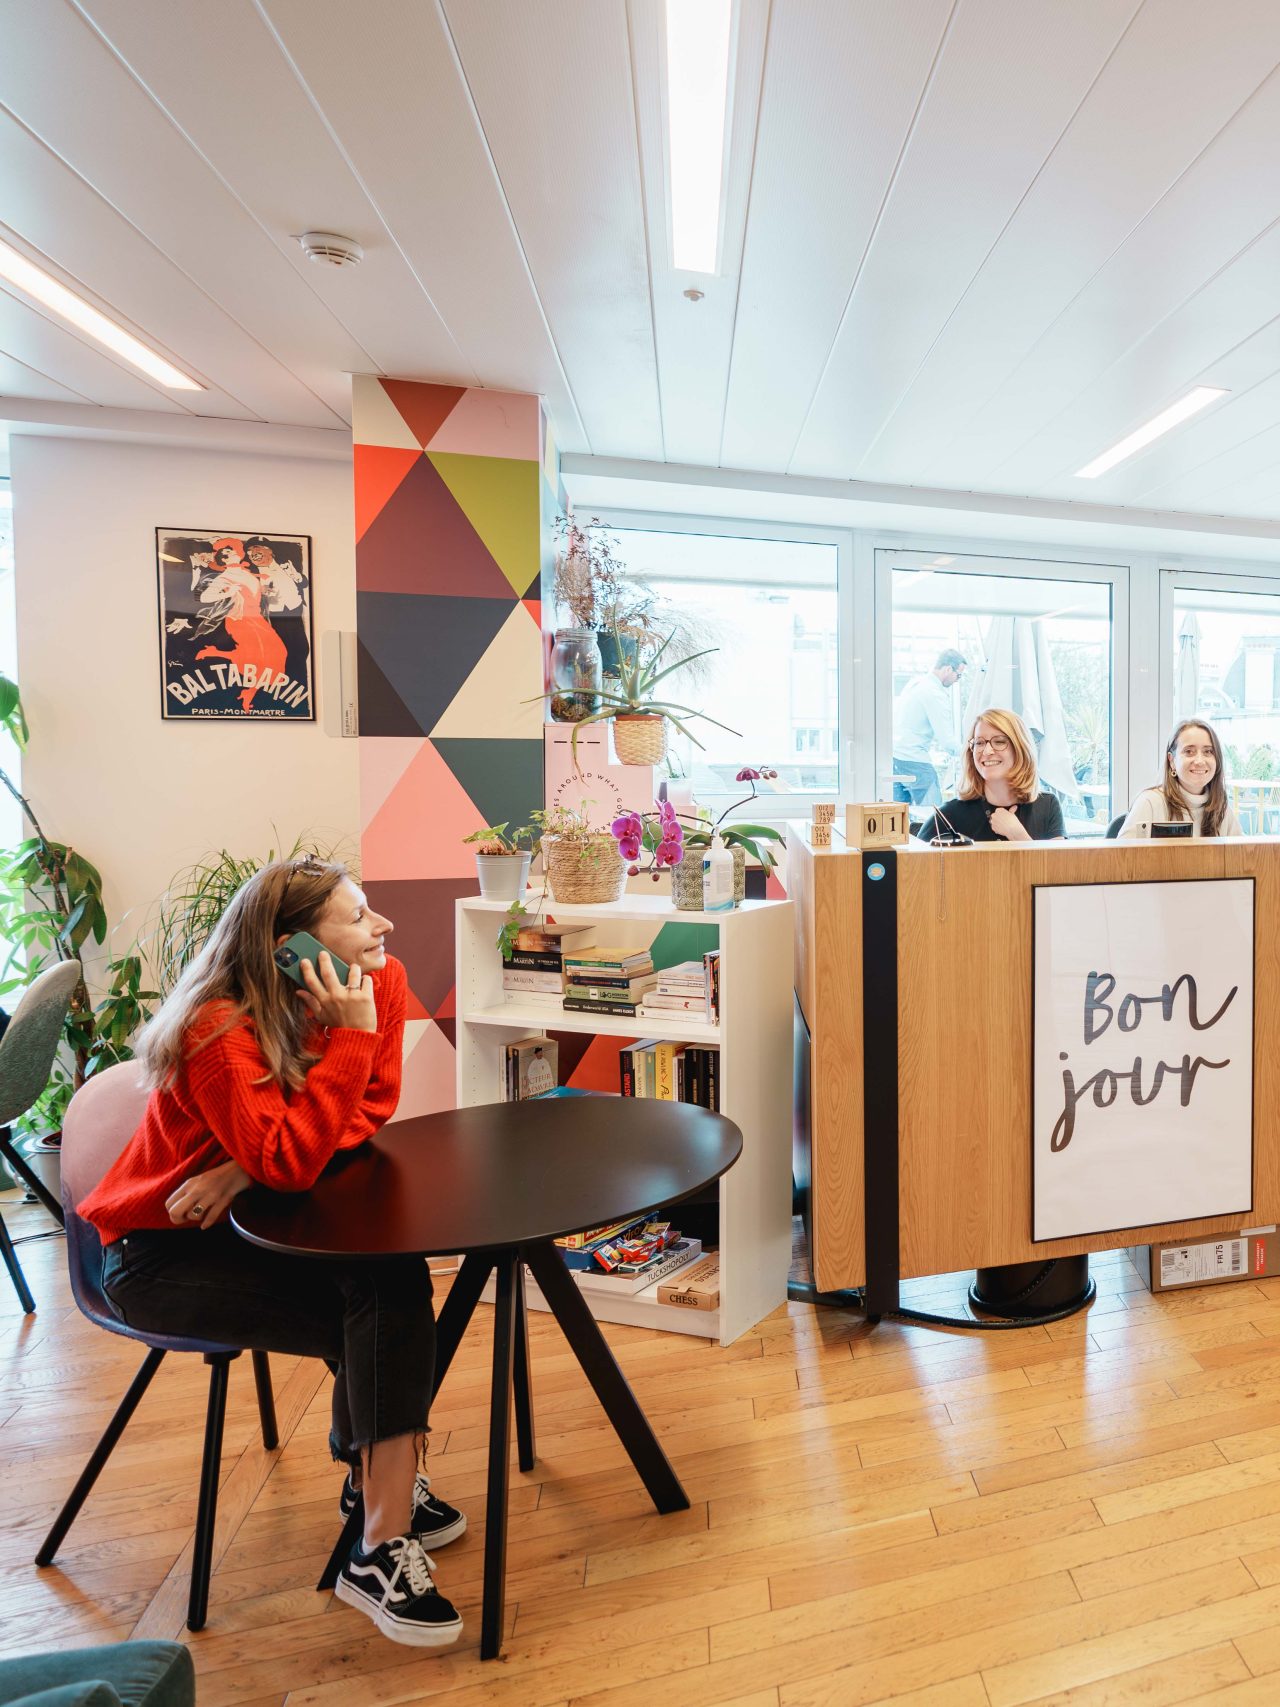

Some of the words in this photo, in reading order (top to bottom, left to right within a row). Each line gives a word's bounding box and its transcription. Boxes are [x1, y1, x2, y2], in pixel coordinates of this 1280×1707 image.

[166, 669, 217, 705] BAL
[210, 663, 308, 709] TABARIN
[597, 774, 619, 792] WHAT
[1084, 970, 1238, 1045] Bon
[1050, 1051, 1231, 1152] jour
[647, 1253, 691, 1282] TUCKSHOPOLY
[669, 1294, 698, 1306] CHESS
